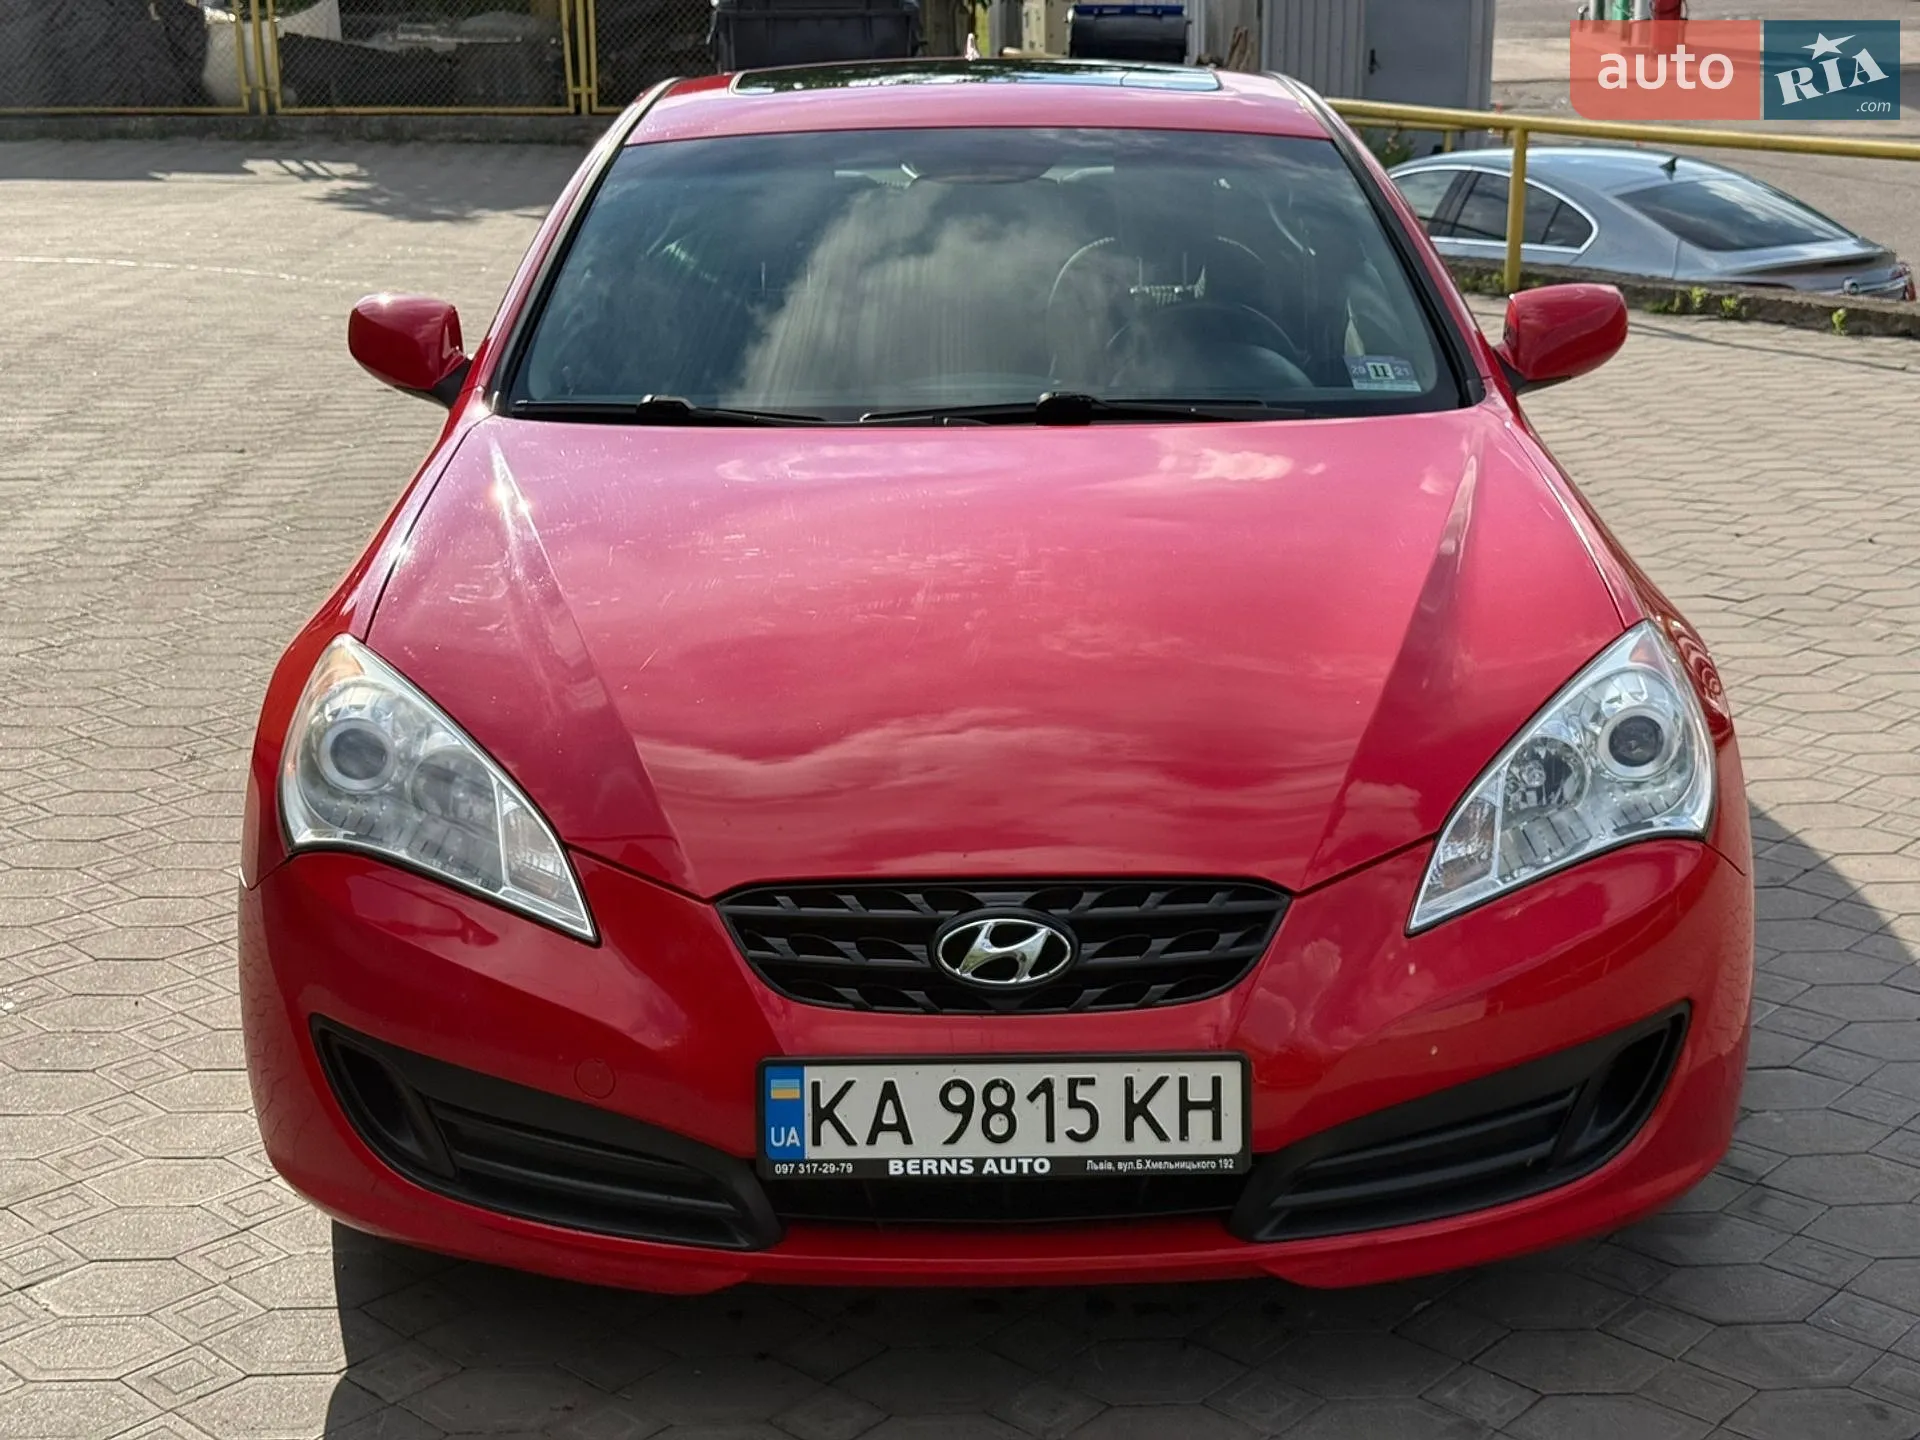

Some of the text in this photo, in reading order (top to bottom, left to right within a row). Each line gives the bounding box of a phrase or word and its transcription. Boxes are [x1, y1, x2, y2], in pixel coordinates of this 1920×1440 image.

[811, 1074, 1223, 1147] KA 9815 KH
[770, 1127, 801, 1147] UA
[774, 1163, 794, 1175] 097
[887, 1157, 1051, 1176] BERNS AUTO
[1219, 1158, 1234, 1169] 192
